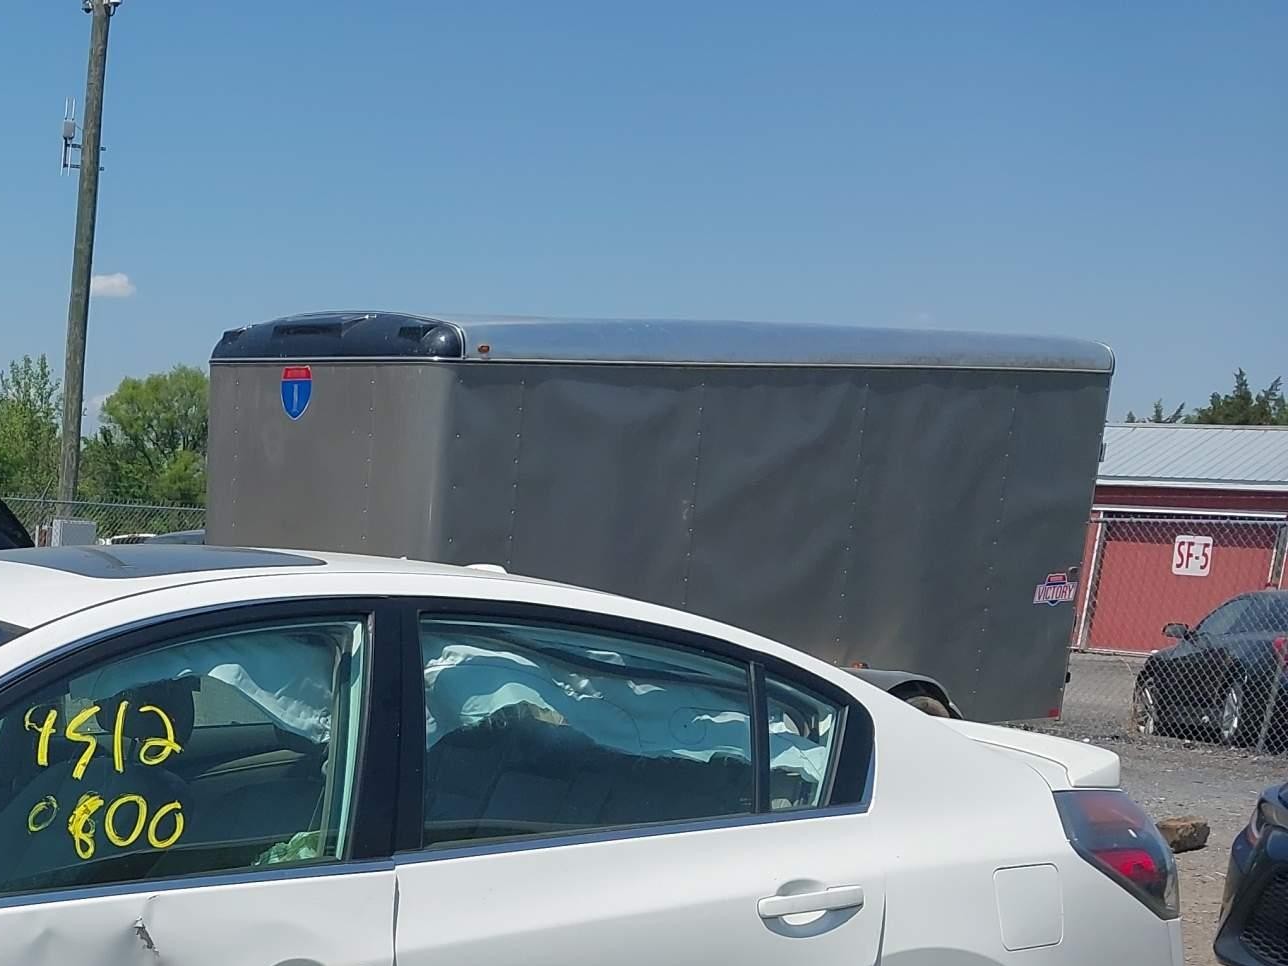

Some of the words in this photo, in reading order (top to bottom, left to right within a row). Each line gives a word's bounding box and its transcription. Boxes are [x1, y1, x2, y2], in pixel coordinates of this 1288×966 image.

[1175, 541, 1211, 570] SF-5
[1038, 583, 1075, 601] VICTORY
[27, 791, 185, 860] 0800
